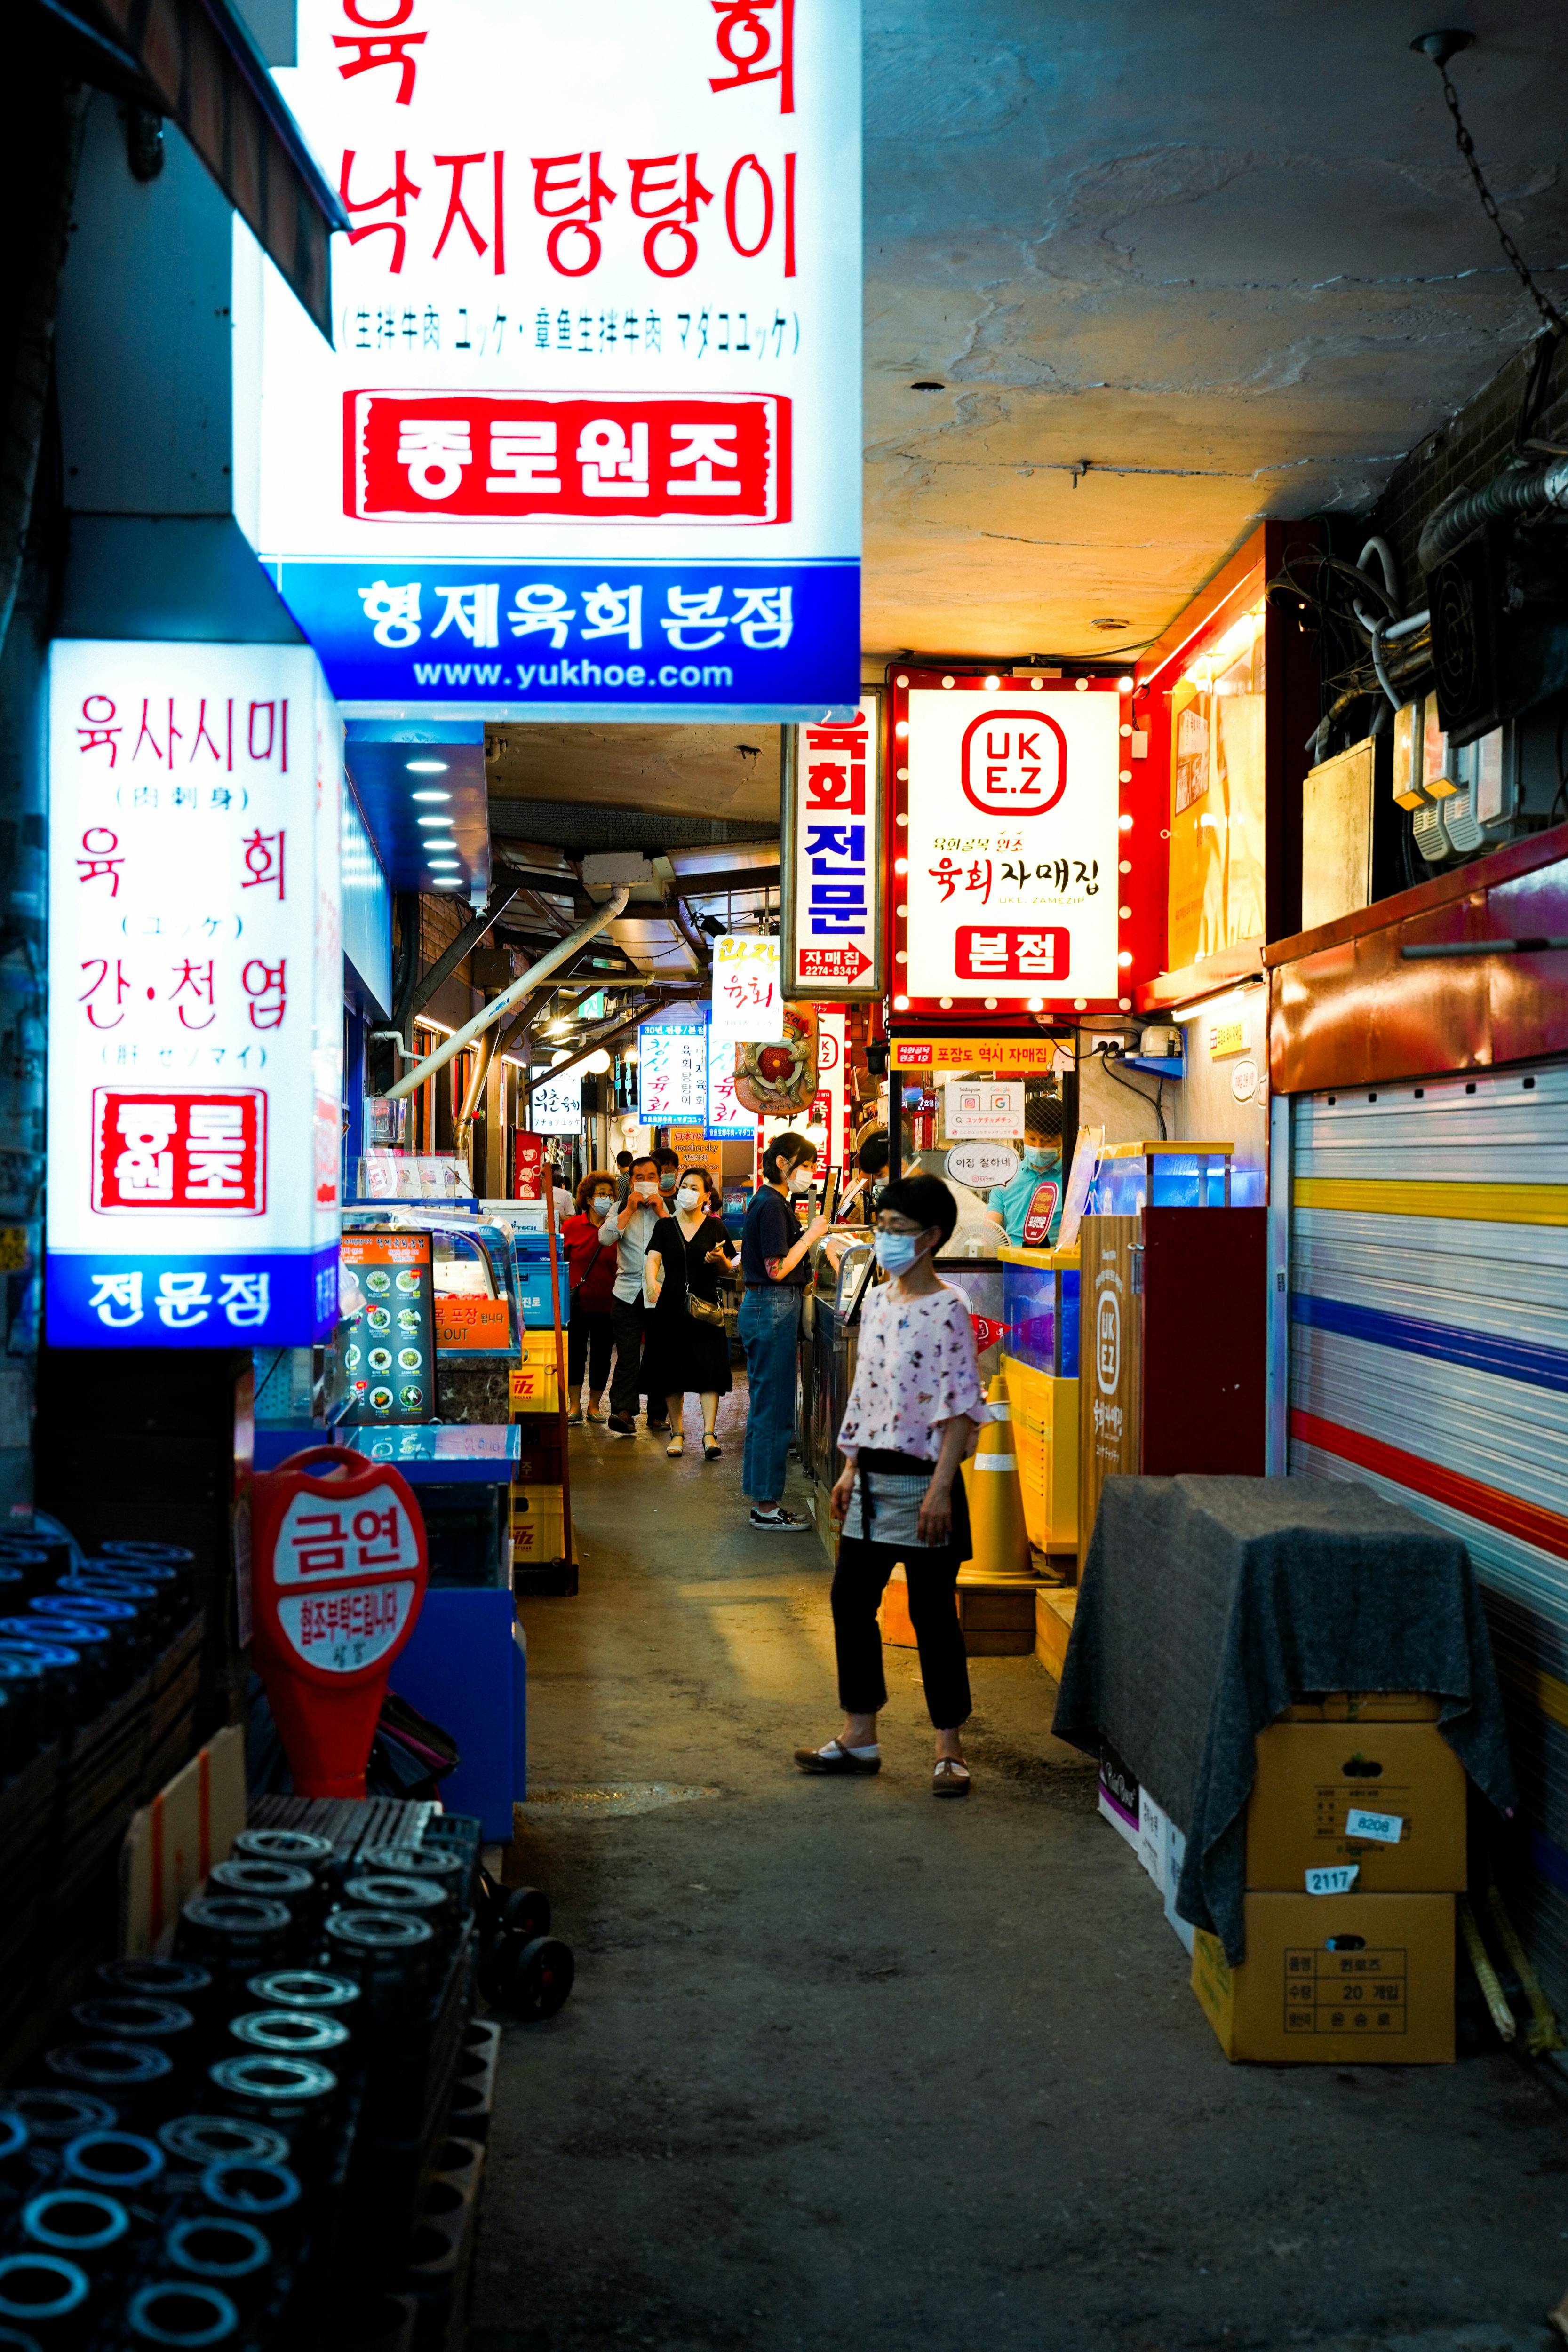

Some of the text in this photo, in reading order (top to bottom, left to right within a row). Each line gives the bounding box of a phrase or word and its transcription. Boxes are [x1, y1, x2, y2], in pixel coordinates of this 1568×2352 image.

[339, 149, 797, 278] 낙지탕탕이
[397, 418, 742, 500] 종로원조
[358, 580, 794, 650] 형제육회 본점
[413, 661, 733, 691] www.yukhoe.com
[76, 695, 288, 773] 육사시미
[933, 837, 990, 852] 육회골목
[805, 950, 860, 966] 자매집
[969, 932, 1055, 973] 본점
[805, 966, 858, 977] 2274-8344
[724, 975, 772, 1009] 육회
[937, 1047, 1047, 1063] 포장도 역시 자매집
[644, 1039, 671, 1112] 창신육회
[681, 1045, 692, 1105] 육회탕탕이
[675, 1143, 718, 1154] another sky
[956, 1158, 1010, 1168] 이집 잘하네
[88, 1271, 271, 1328] 전문점
[450, 1307, 478, 1326] 포장
[481, 1313, 504, 1324] 됩니다
[444, 1328, 469, 1341] OUT
[291, 1504, 400, 1575] 금연
[1358, 1816, 1390, 1833] 8208
[1313, 1870, 1348, 1890] 2117
[1343, 1985, 1363, 2000] 20
